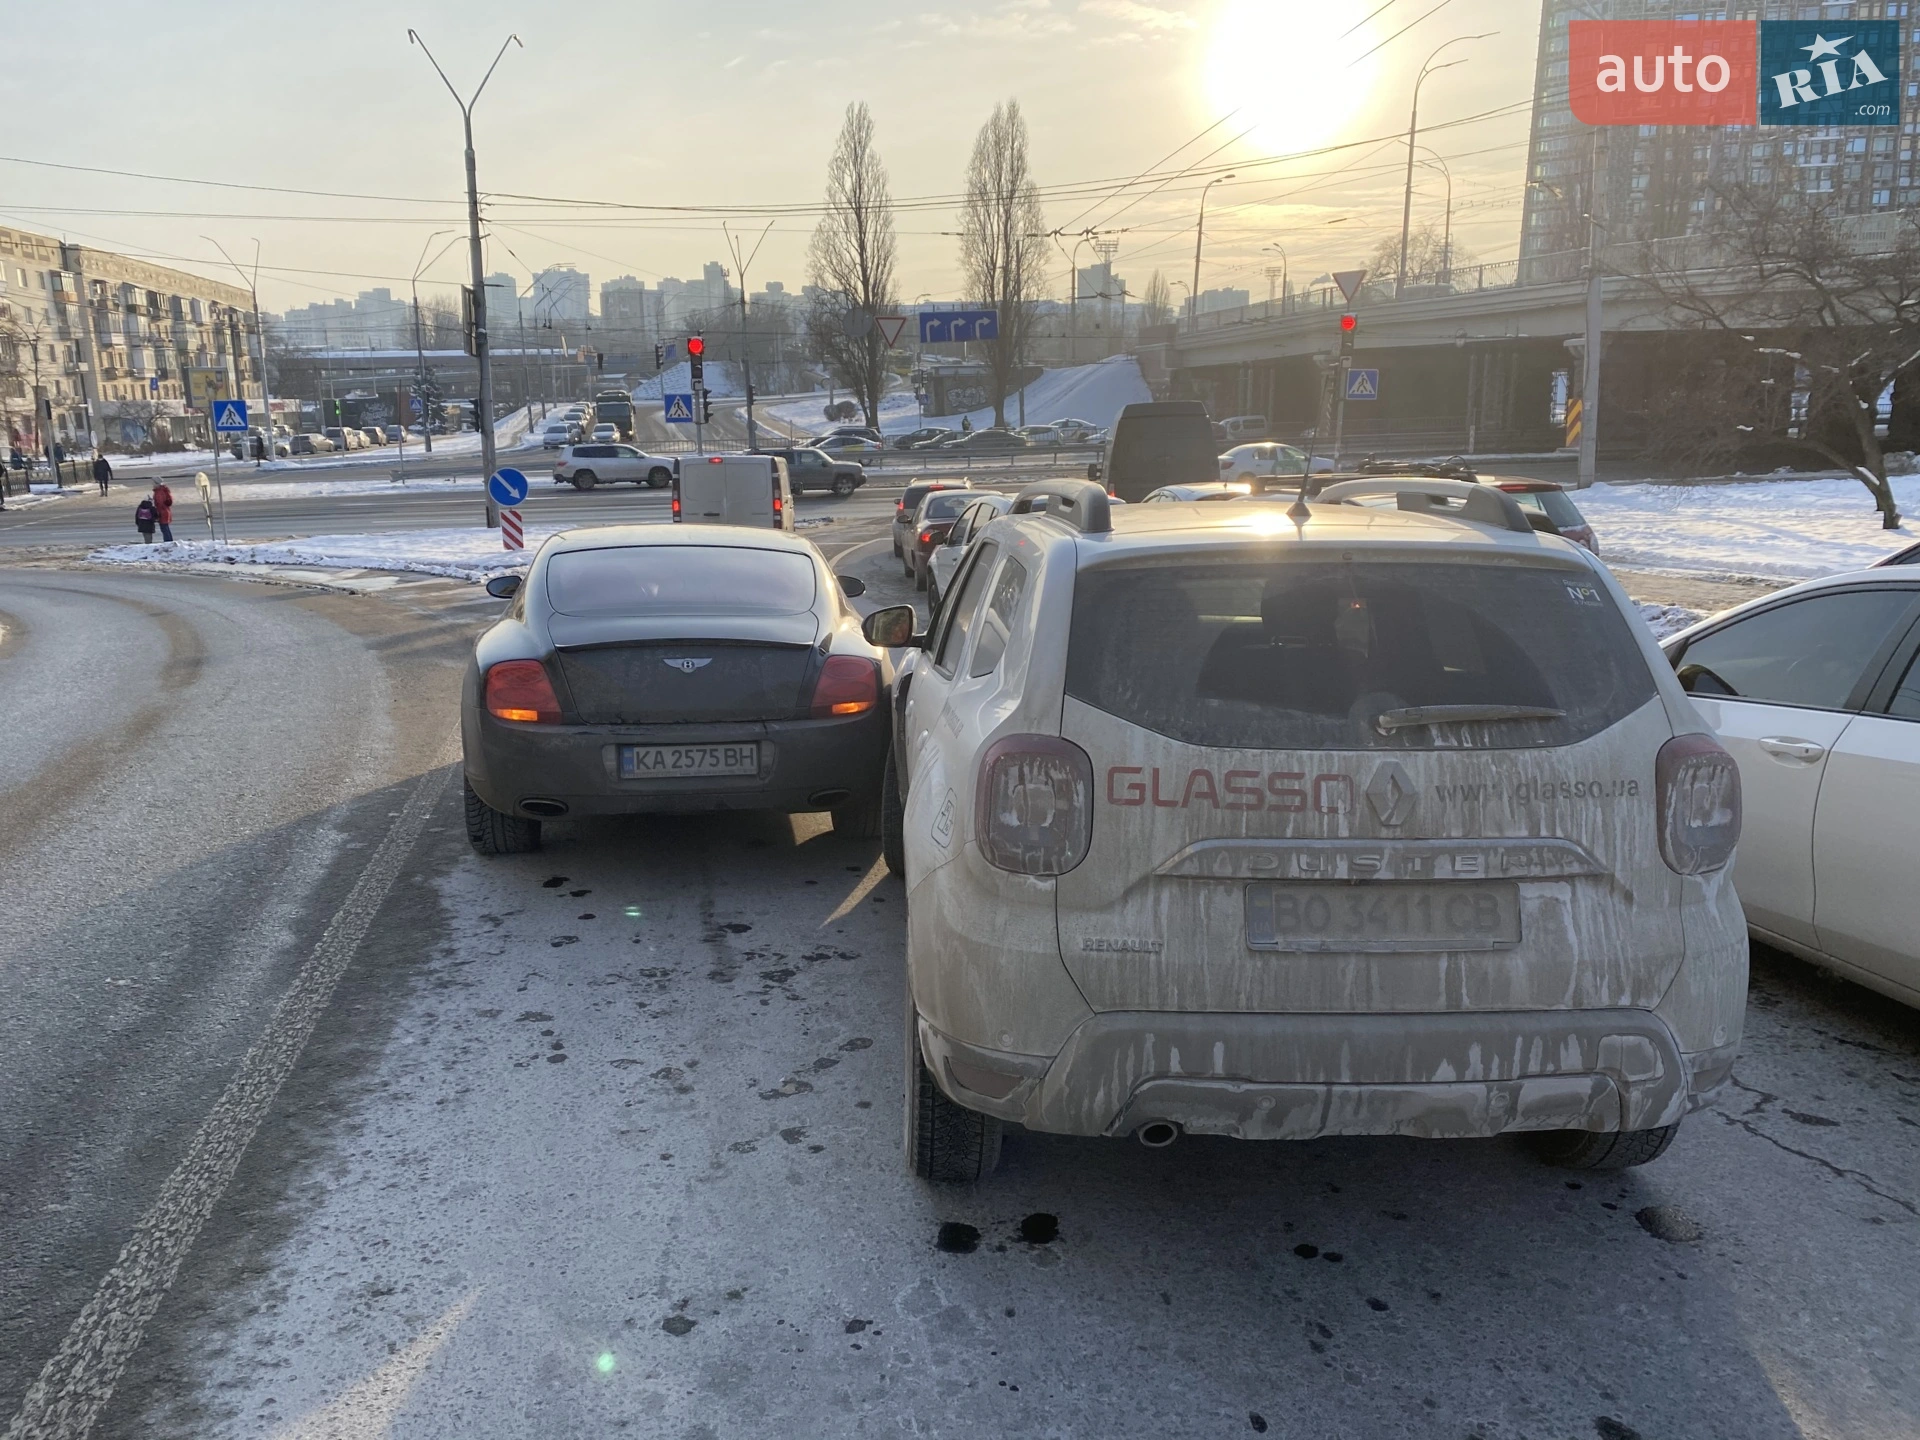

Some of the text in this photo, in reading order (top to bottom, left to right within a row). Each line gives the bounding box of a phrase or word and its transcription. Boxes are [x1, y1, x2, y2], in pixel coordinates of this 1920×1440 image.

[1106, 766, 1354, 814] GLASSO
[1435, 776, 1639, 806] ww.glasso.ua
[1248, 853, 1529, 872] DUSTER
[1081, 938, 1163, 954] RENAULT
